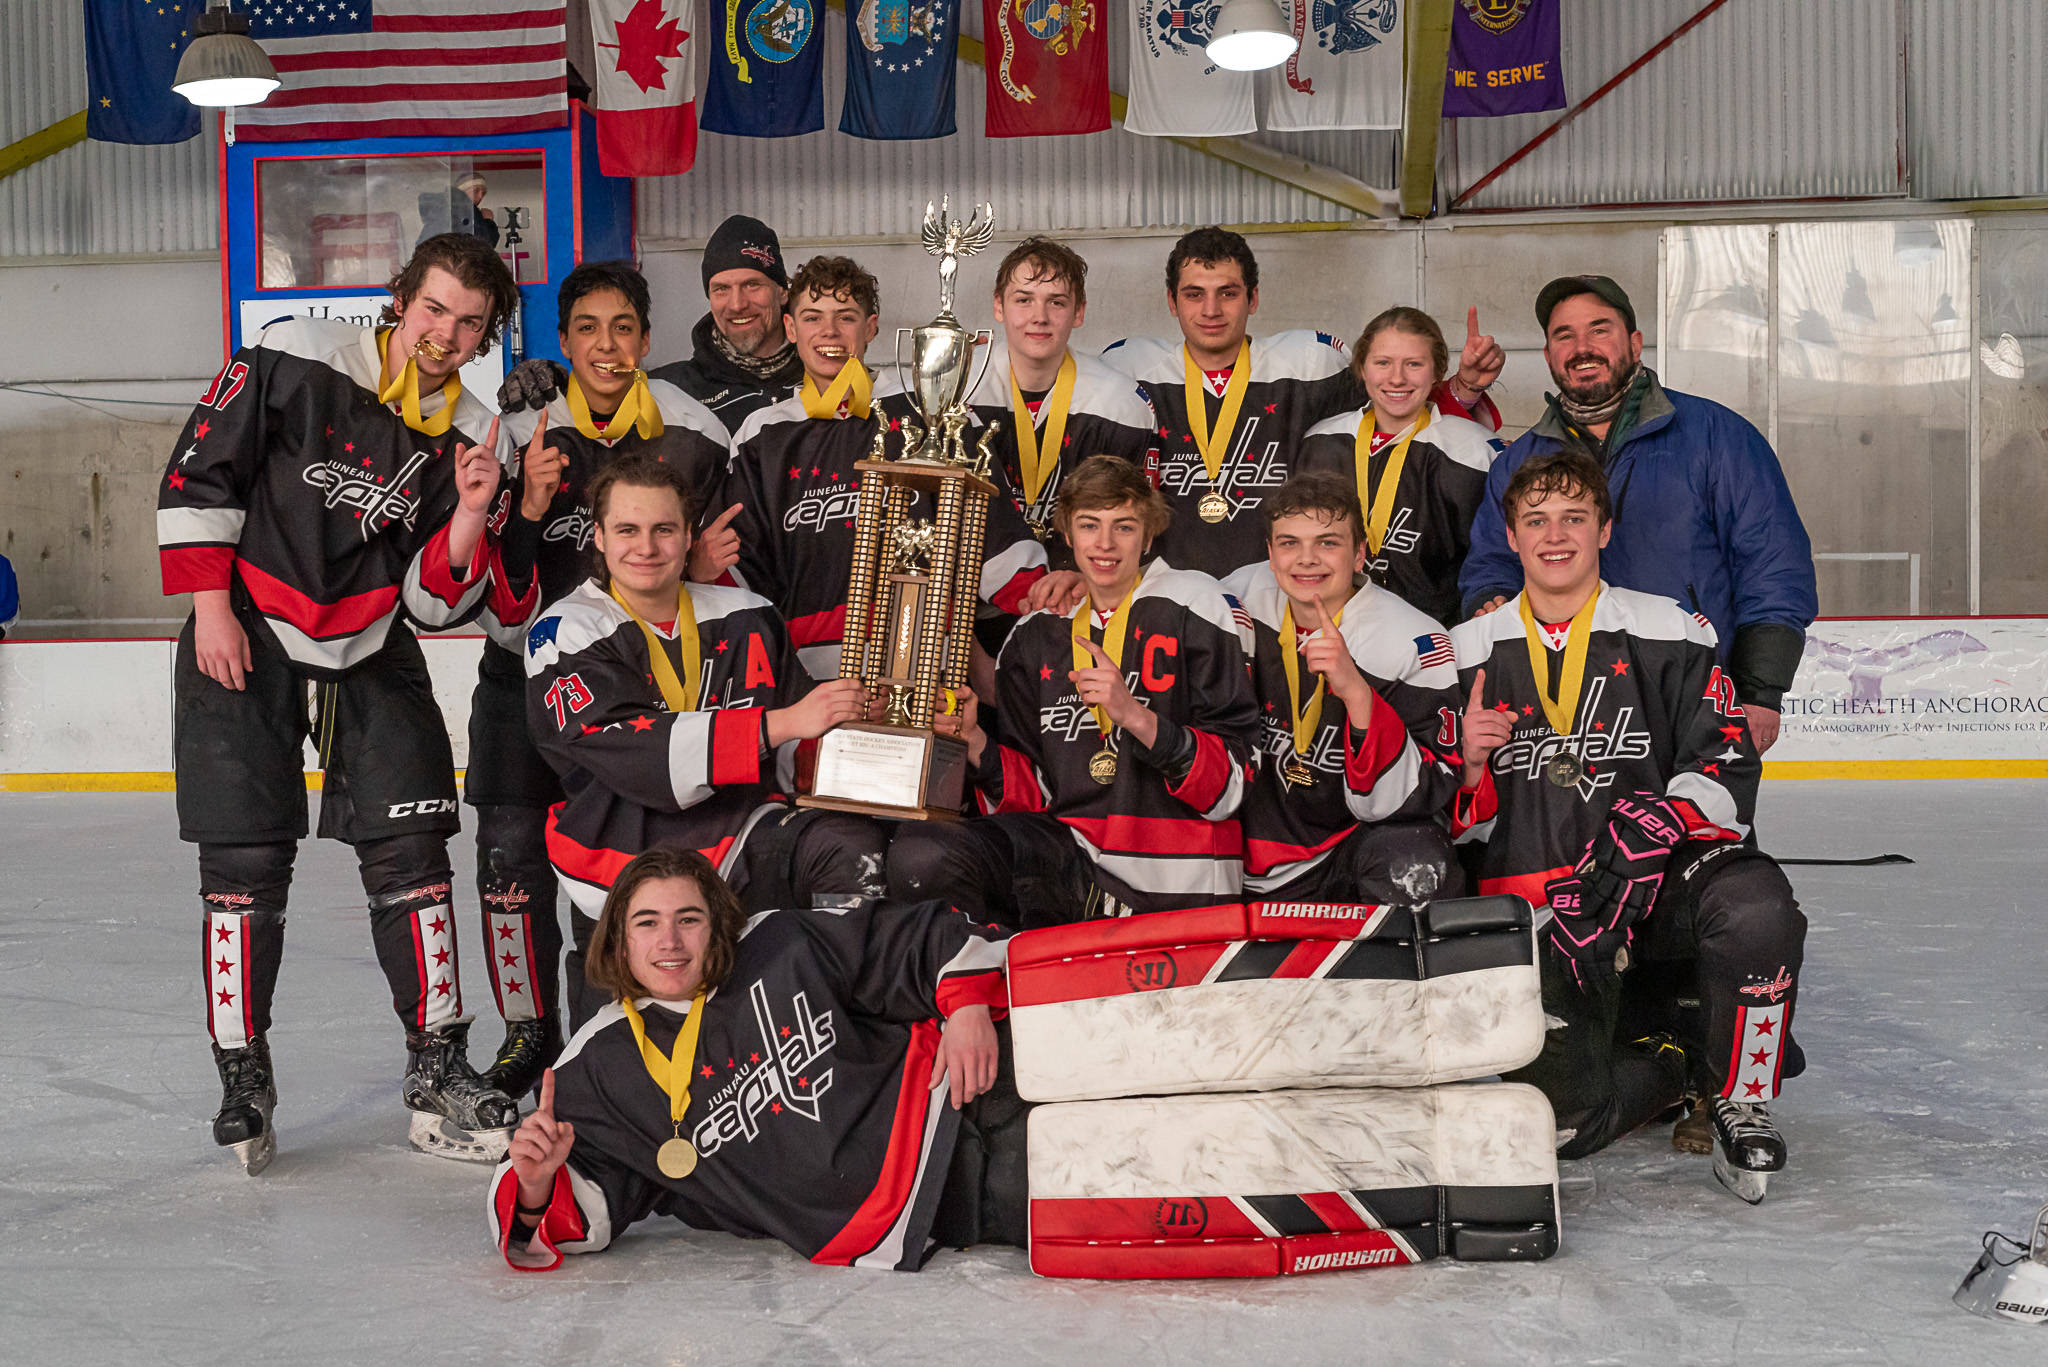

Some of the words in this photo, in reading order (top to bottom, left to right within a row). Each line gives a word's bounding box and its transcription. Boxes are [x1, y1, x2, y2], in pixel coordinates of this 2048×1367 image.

[1001, 25, 1013, 64] MARINE
[1146, 16, 1161, 58] PARATUS
[728, 43, 741, 61] NAVY
[1000, 70, 1019, 98] CORPS
[327, 459, 376, 482] JUNEAU
[802, 483, 847, 499] JUNEAU
[744, 632, 776, 690] A
[1141, 633, 1178, 693] C
[544, 672, 595, 732] 73
[1702, 665, 1747, 718] 42
[1833, 698, 1916, 715] HEALTH
[1947, 722, 2011, 733] INJECTIONS
[388, 799, 457, 819] CCM
[1261, 903, 1368, 920] WARRIOR
[691, 978, 837, 1159] capitals
[1293, 1247, 1398, 1273] WARRIOR
